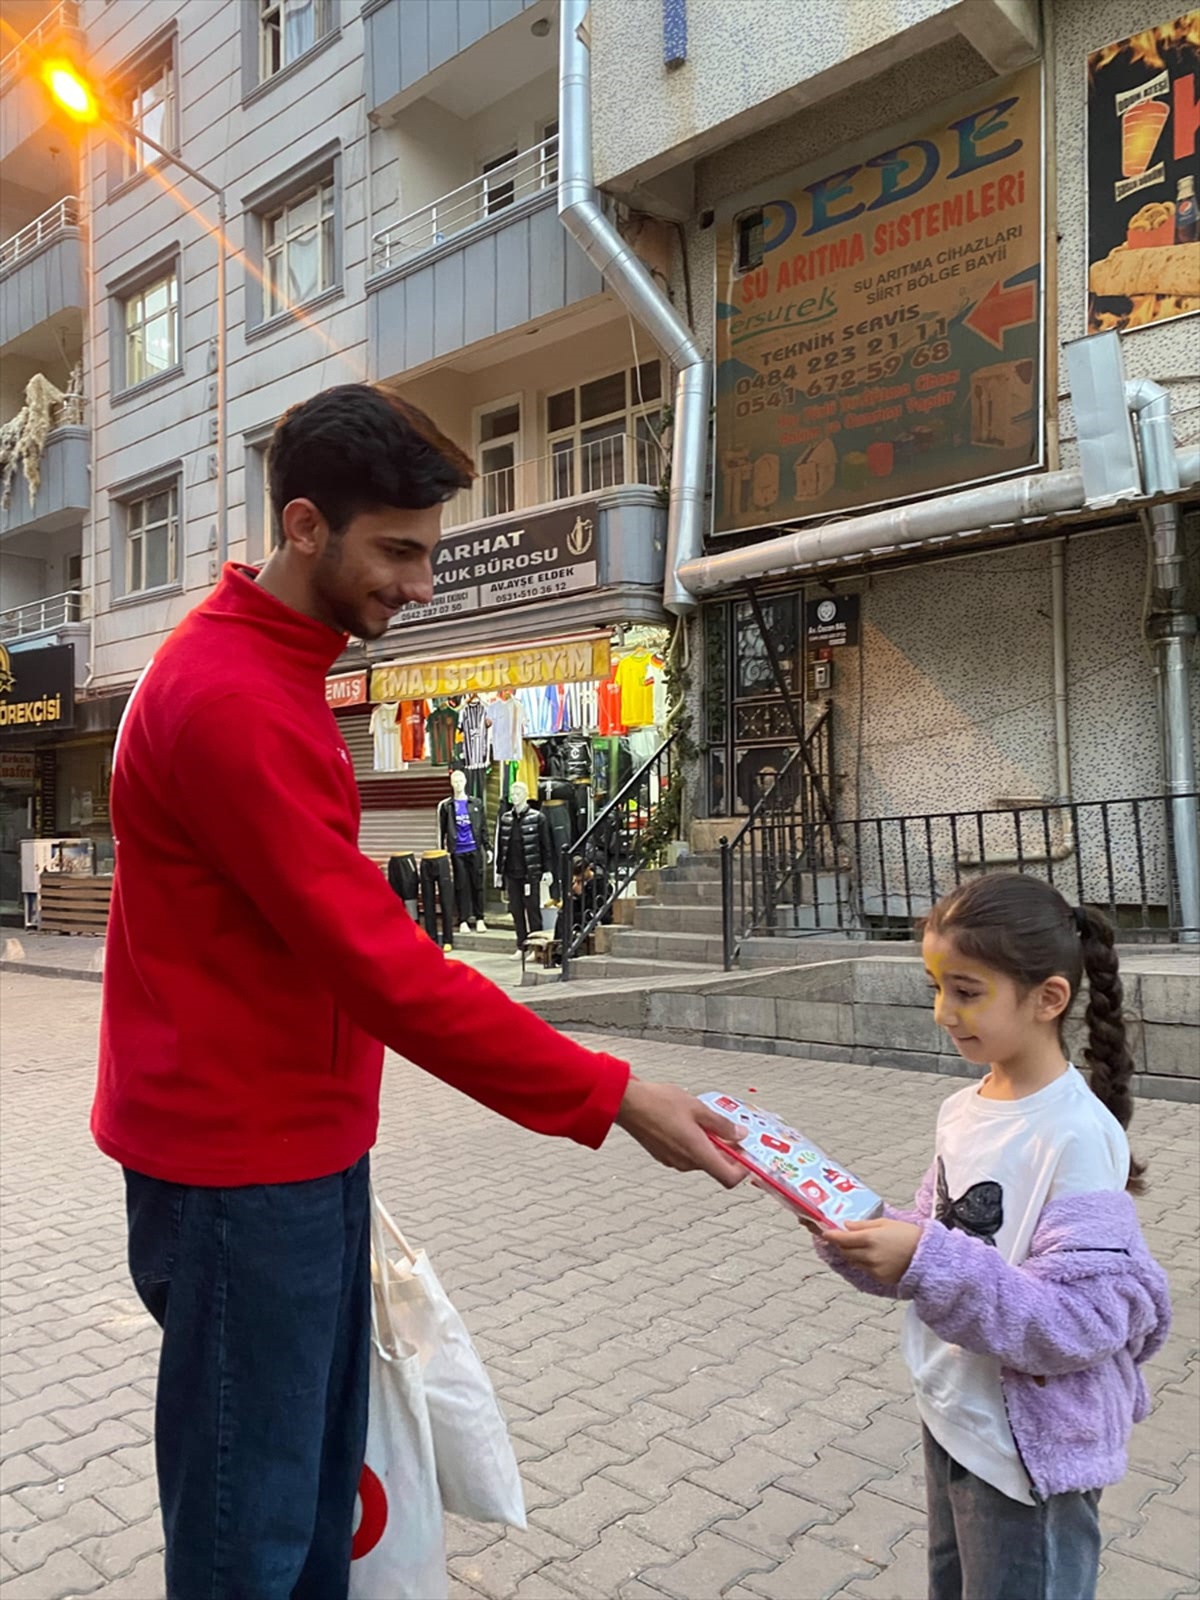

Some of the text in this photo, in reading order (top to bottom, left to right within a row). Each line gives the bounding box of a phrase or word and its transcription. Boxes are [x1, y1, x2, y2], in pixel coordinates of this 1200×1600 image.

[741, 170, 1025, 304] SU ARITMA SİSTEMLERİ
[853, 224, 1023, 294] SU ARITMA CİHAZLARI
[735, 317, 949, 397] 0484 223 21 11
[760, 304, 921, 367] TEKNİK SERVİS
[735, 388, 795, 418] 0541
[911, 342, 950, 368] 68
[474, 547, 558, 577] BÜROSU
[555, 581, 567, 592] 12
[444, 659, 511, 691] SPOR
